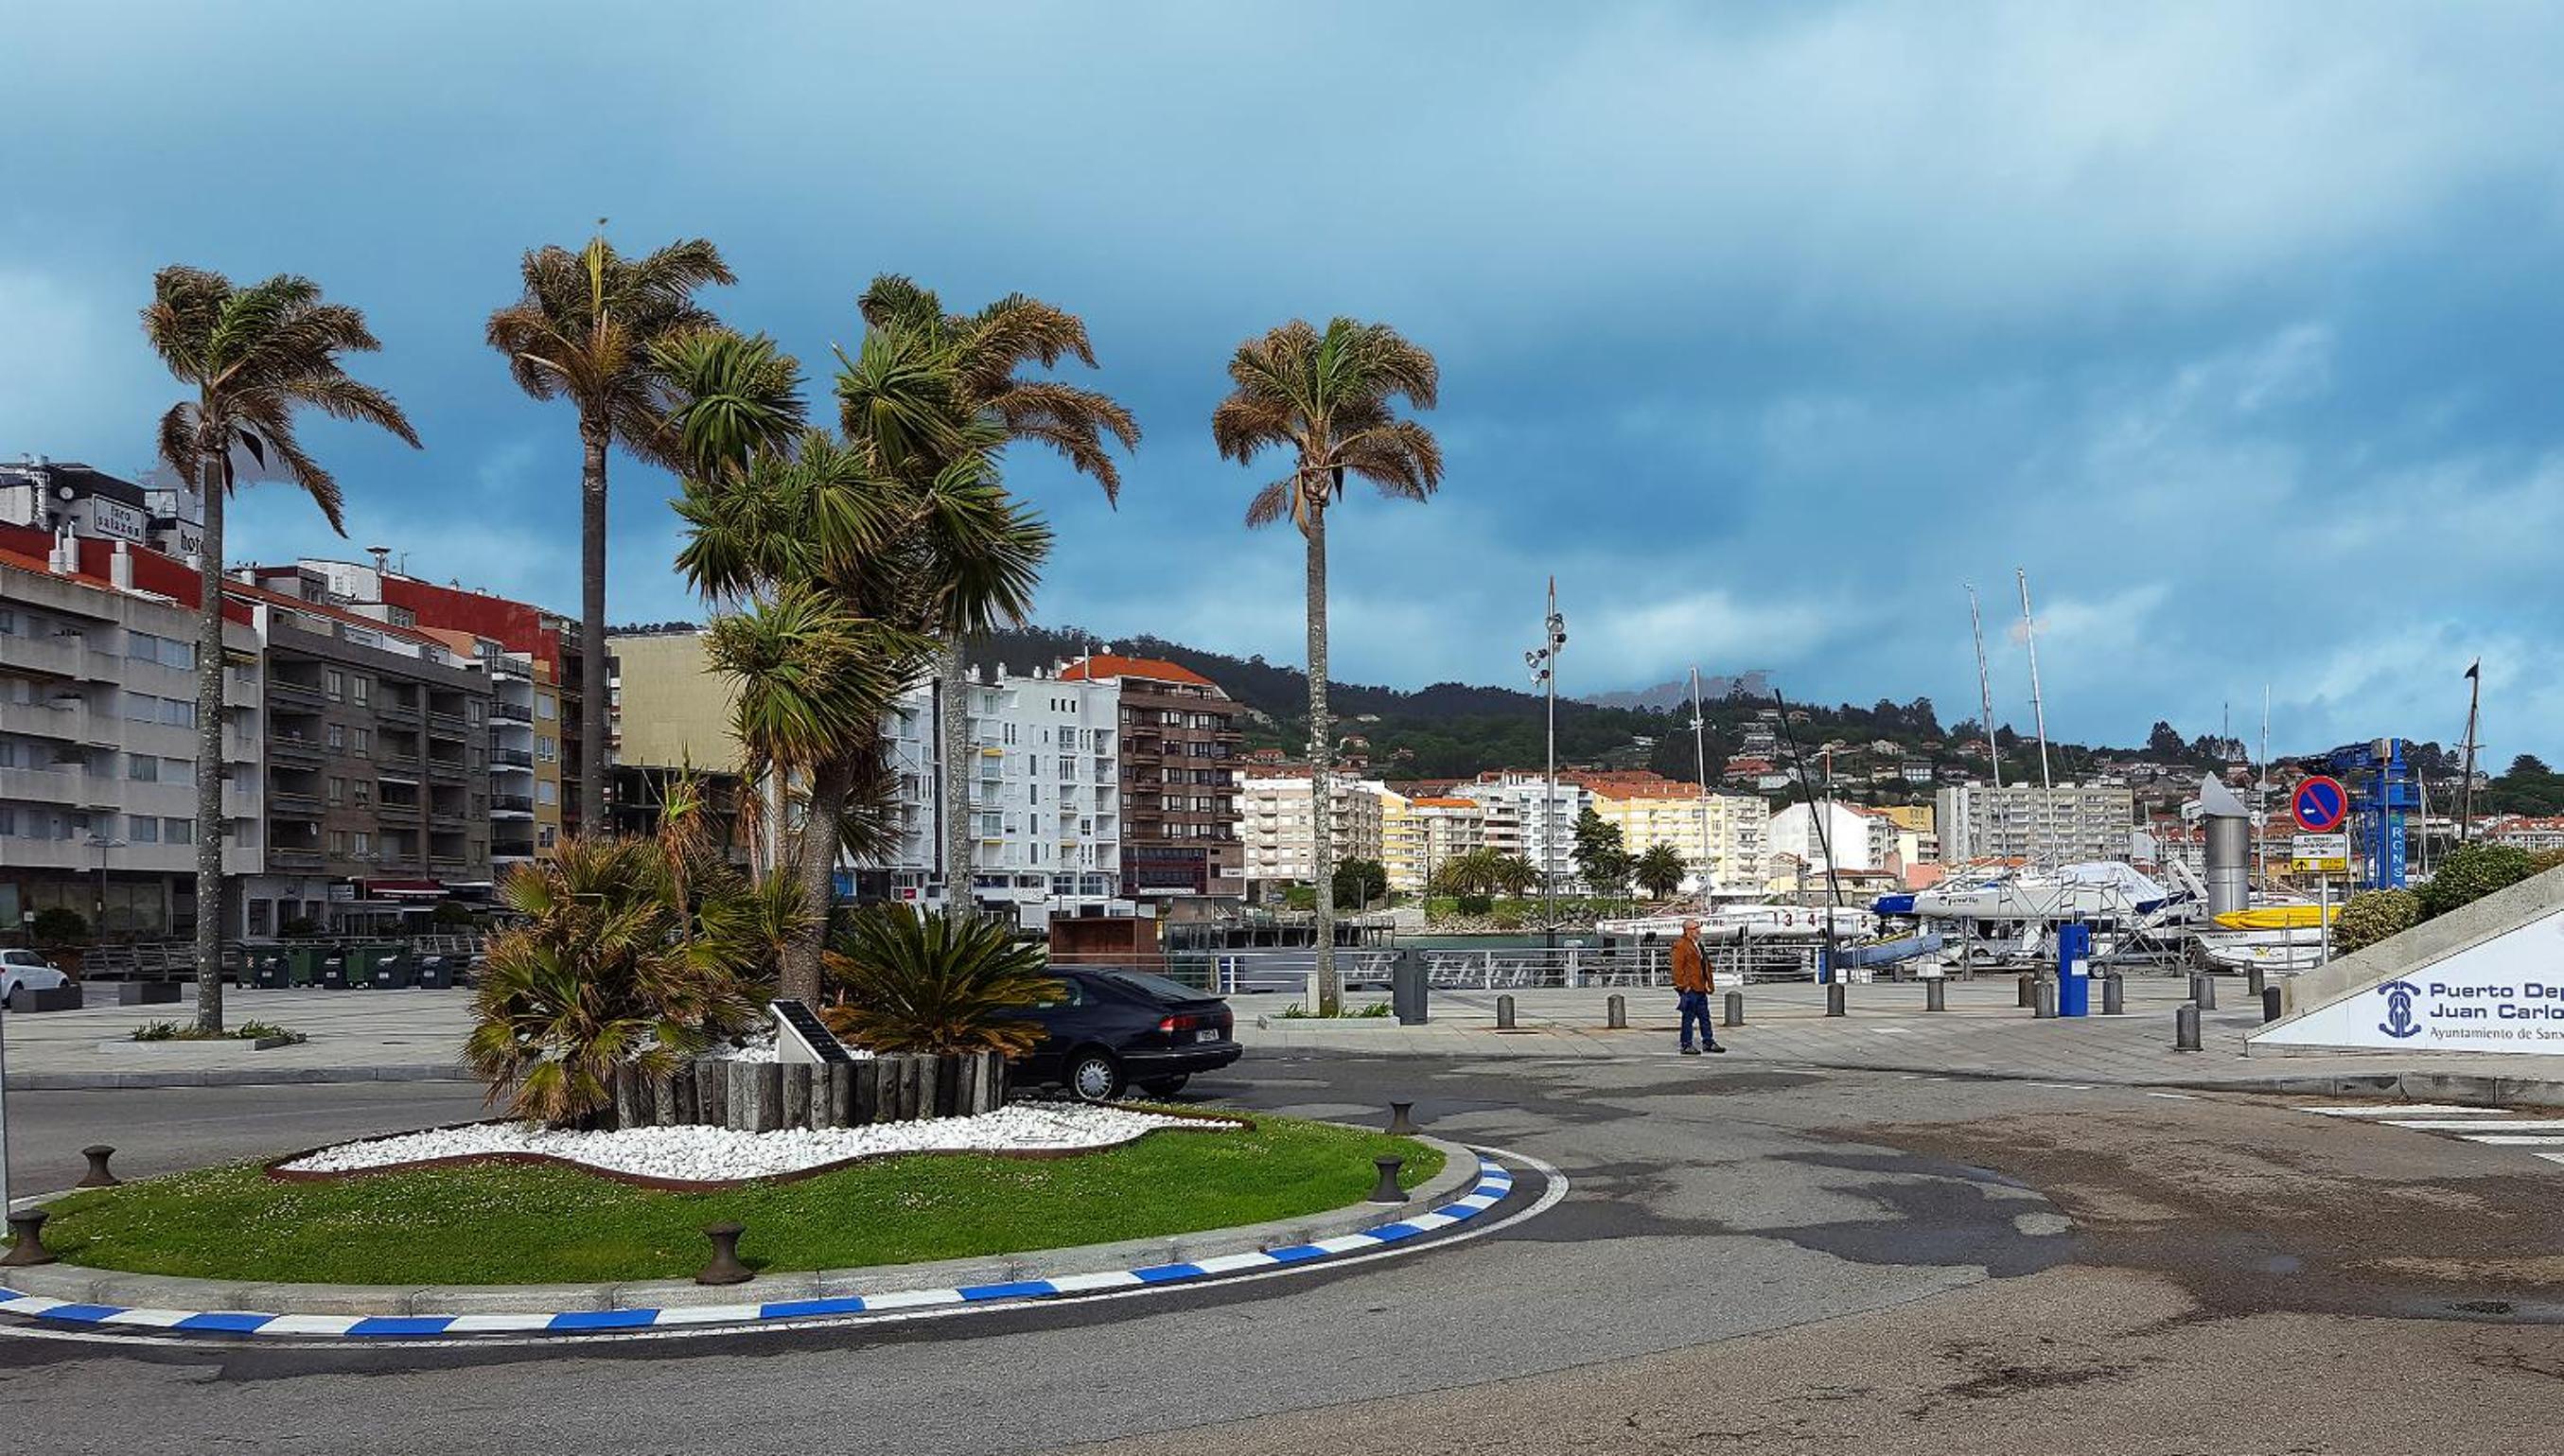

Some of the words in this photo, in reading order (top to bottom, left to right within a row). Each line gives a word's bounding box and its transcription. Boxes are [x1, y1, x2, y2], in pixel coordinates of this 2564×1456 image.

[181, 529, 204, 553] hote
[2195, 903, 2203, 917] 2
[1784, 914, 1793, 926] 3
[1808, 914, 1817, 926] 4
[1860, 915, 1868, 927] 5
[2430, 983, 2514, 997] Puerto
[2430, 1003, 2487, 1018] Juan
[2430, 1026, 2513, 1040] Ayuntamiento
[2518, 1028, 2532, 1039] de
